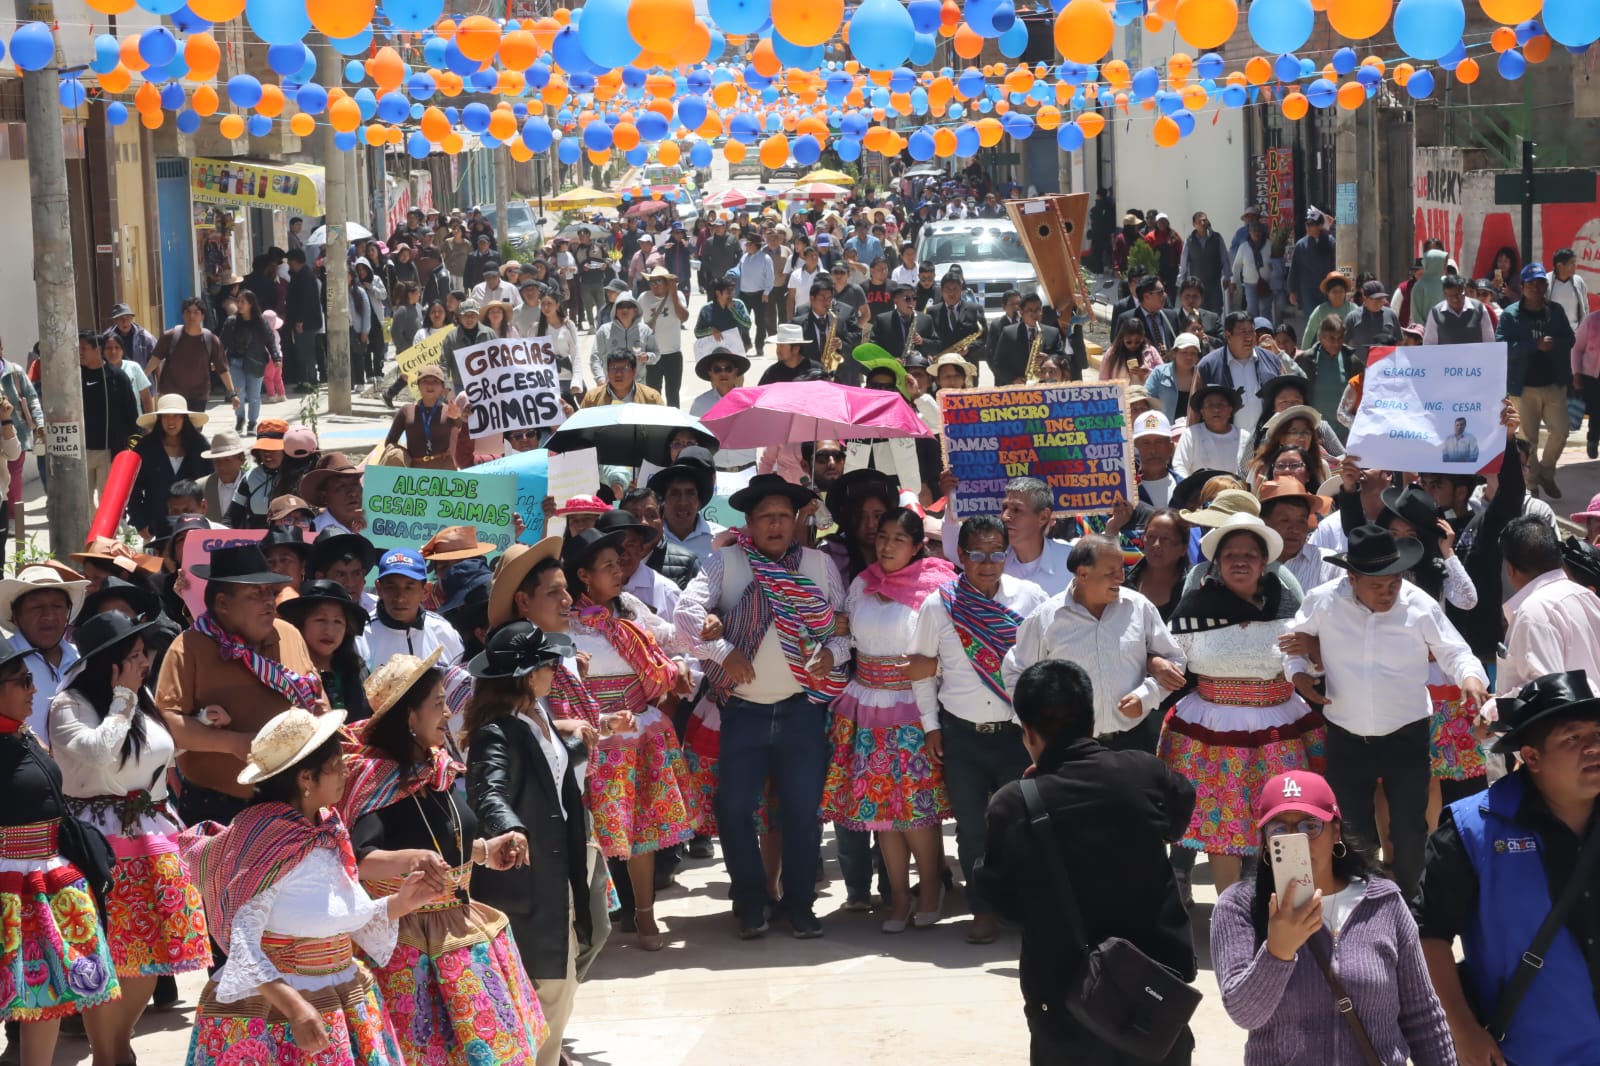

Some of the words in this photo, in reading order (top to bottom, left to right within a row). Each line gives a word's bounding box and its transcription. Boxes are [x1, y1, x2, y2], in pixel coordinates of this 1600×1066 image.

[231, 198, 244, 206] DE
[867, 291, 891, 303] GAP
[465, 341, 554, 376] GRACIAS
[497, 369, 555, 393] CESAR
[1383, 367, 1426, 378] GRACIAS
[1444, 367, 1463, 377] POR
[1465, 367, 1482, 377] LAS
[943, 390, 1043, 409] EXPRESAMOS
[1045, 386, 1121, 403] NUESTRO
[1374, 400, 1408, 411] OBRAS
[1424, 402, 1444, 411] ING.
[1452, 402, 1481, 412] CESAR
[470, 392, 558, 434] DAMAS
[943, 409, 979, 424] MAS
[980, 405, 1049, 422] SINCERO
[1024, 420, 1045, 433] AL
[1044, 418, 1076, 432] ING.
[1074, 415, 1125, 430] CESAR
[948, 437, 999, 451] DAMAS
[1000, 435, 1032, 450] POR
[1033, 431, 1088, 447] HACER
[1389, 430, 1429, 440] DAMAS
[998, 449, 1038, 464] ESTA
[1085, 444, 1119, 459] QUE
[1006, 463, 1029, 477] UN
[1032, 460, 1085, 475] ANTES
[1087, 459, 1099, 472] Y
[1101, 457, 1125, 471] UN
[392, 475, 479, 499] ALCALDE
[1046, 472, 1121, 488] NUESTRO
[1059, 490, 1123, 507] CHILCA
[368, 495, 428, 517] CESAR
[438, 500, 511, 527] DAMAS
[372, 517, 446, 541] GRACI
[1282, 777, 1302, 797] LA
